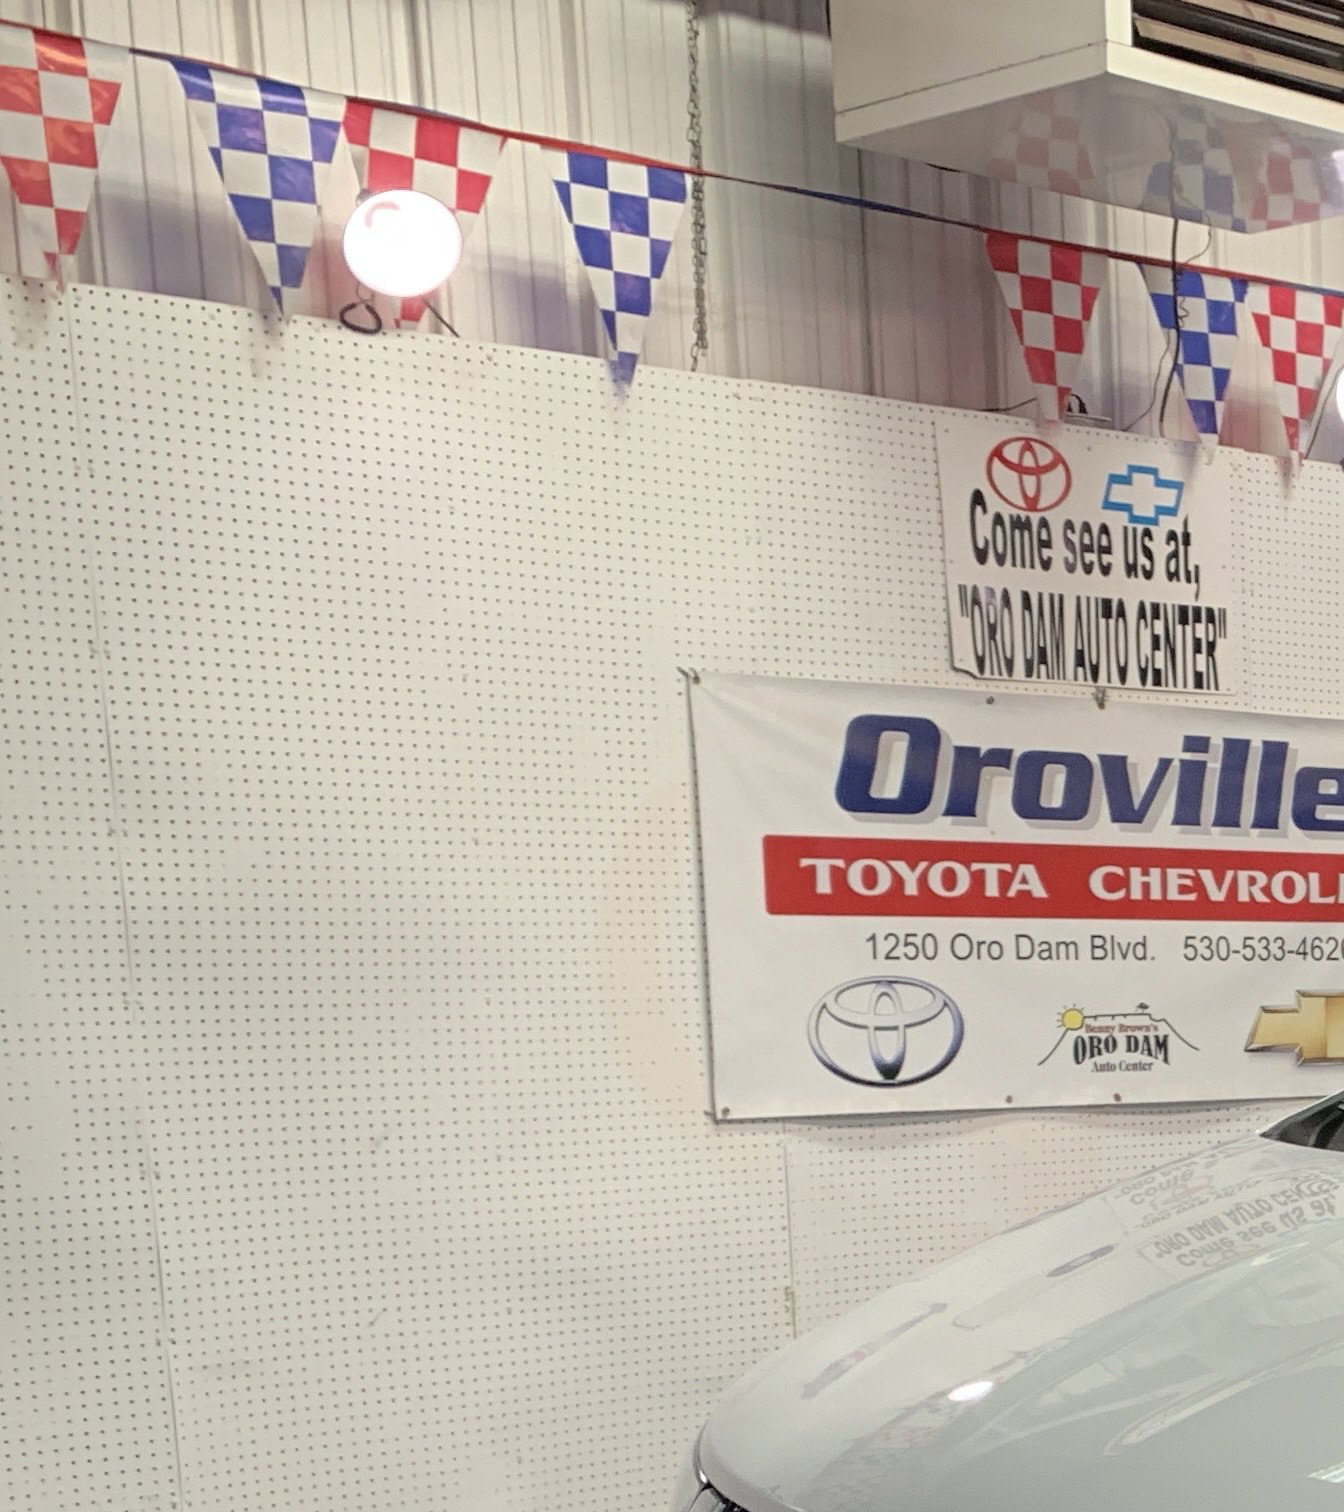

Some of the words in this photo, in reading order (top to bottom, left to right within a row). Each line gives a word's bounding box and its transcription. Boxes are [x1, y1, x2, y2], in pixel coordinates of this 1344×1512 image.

[969, 487, 1053, 572] Come
[1062, 518, 1113, 577] see
[1122, 525, 1155, 580] us
[1165, 514, 1200, 601] at,
[957, 583, 1016, 679] "ORO
[1020, 589, 1067, 681] DAM
[1073, 595, 1129, 686] AUTO
[1135, 600, 1228, 692] CENTER"
[799, 857, 1049, 899] TOYOTA
[865, 931, 938, 961] 1250
[950, 932, 1004, 963] Oro
[1015, 934, 1081, 963] Dam
[1090, 935, 1156, 963] Blvd.
[1118, 1023, 1159, 1033] Brown's
[1073, 1035, 1118, 1065] ORO
[1126, 1034, 1170, 1065] DAM
[1091, 1061, 1116, 1073] Auto
[1119, 1060, 1154, 1073] Center
